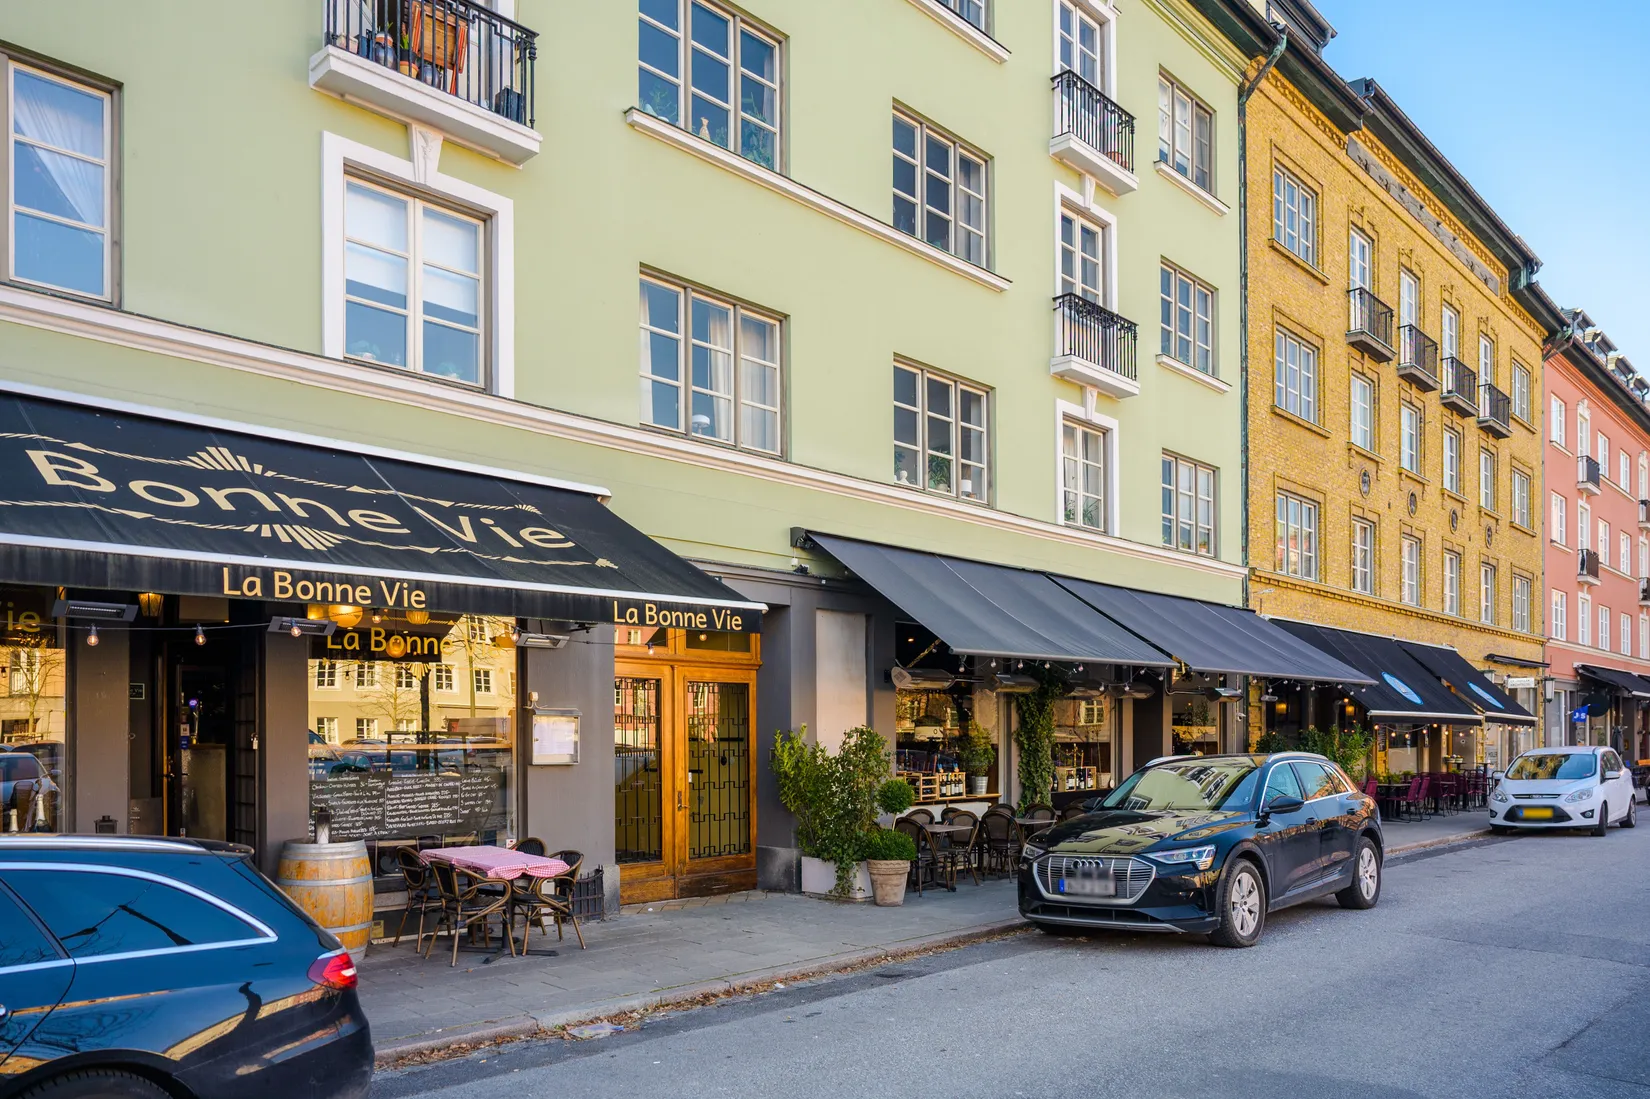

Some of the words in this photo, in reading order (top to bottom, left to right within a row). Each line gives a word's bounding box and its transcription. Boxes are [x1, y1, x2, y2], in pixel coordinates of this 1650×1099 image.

[25, 450, 411, 534] Bonne
[413, 506, 576, 549] Vie
[223, 567, 262, 597] La
[274, 571, 372, 606] Bonne
[380, 580, 427, 609] Vie
[0, 601, 41, 632] ie
[613, 600, 639, 625] La
[645, 603, 708, 629] Bonne
[712, 608, 743, 631] Vie
[327, 629, 360, 651] La
[371, 627, 453, 656] Bonne
